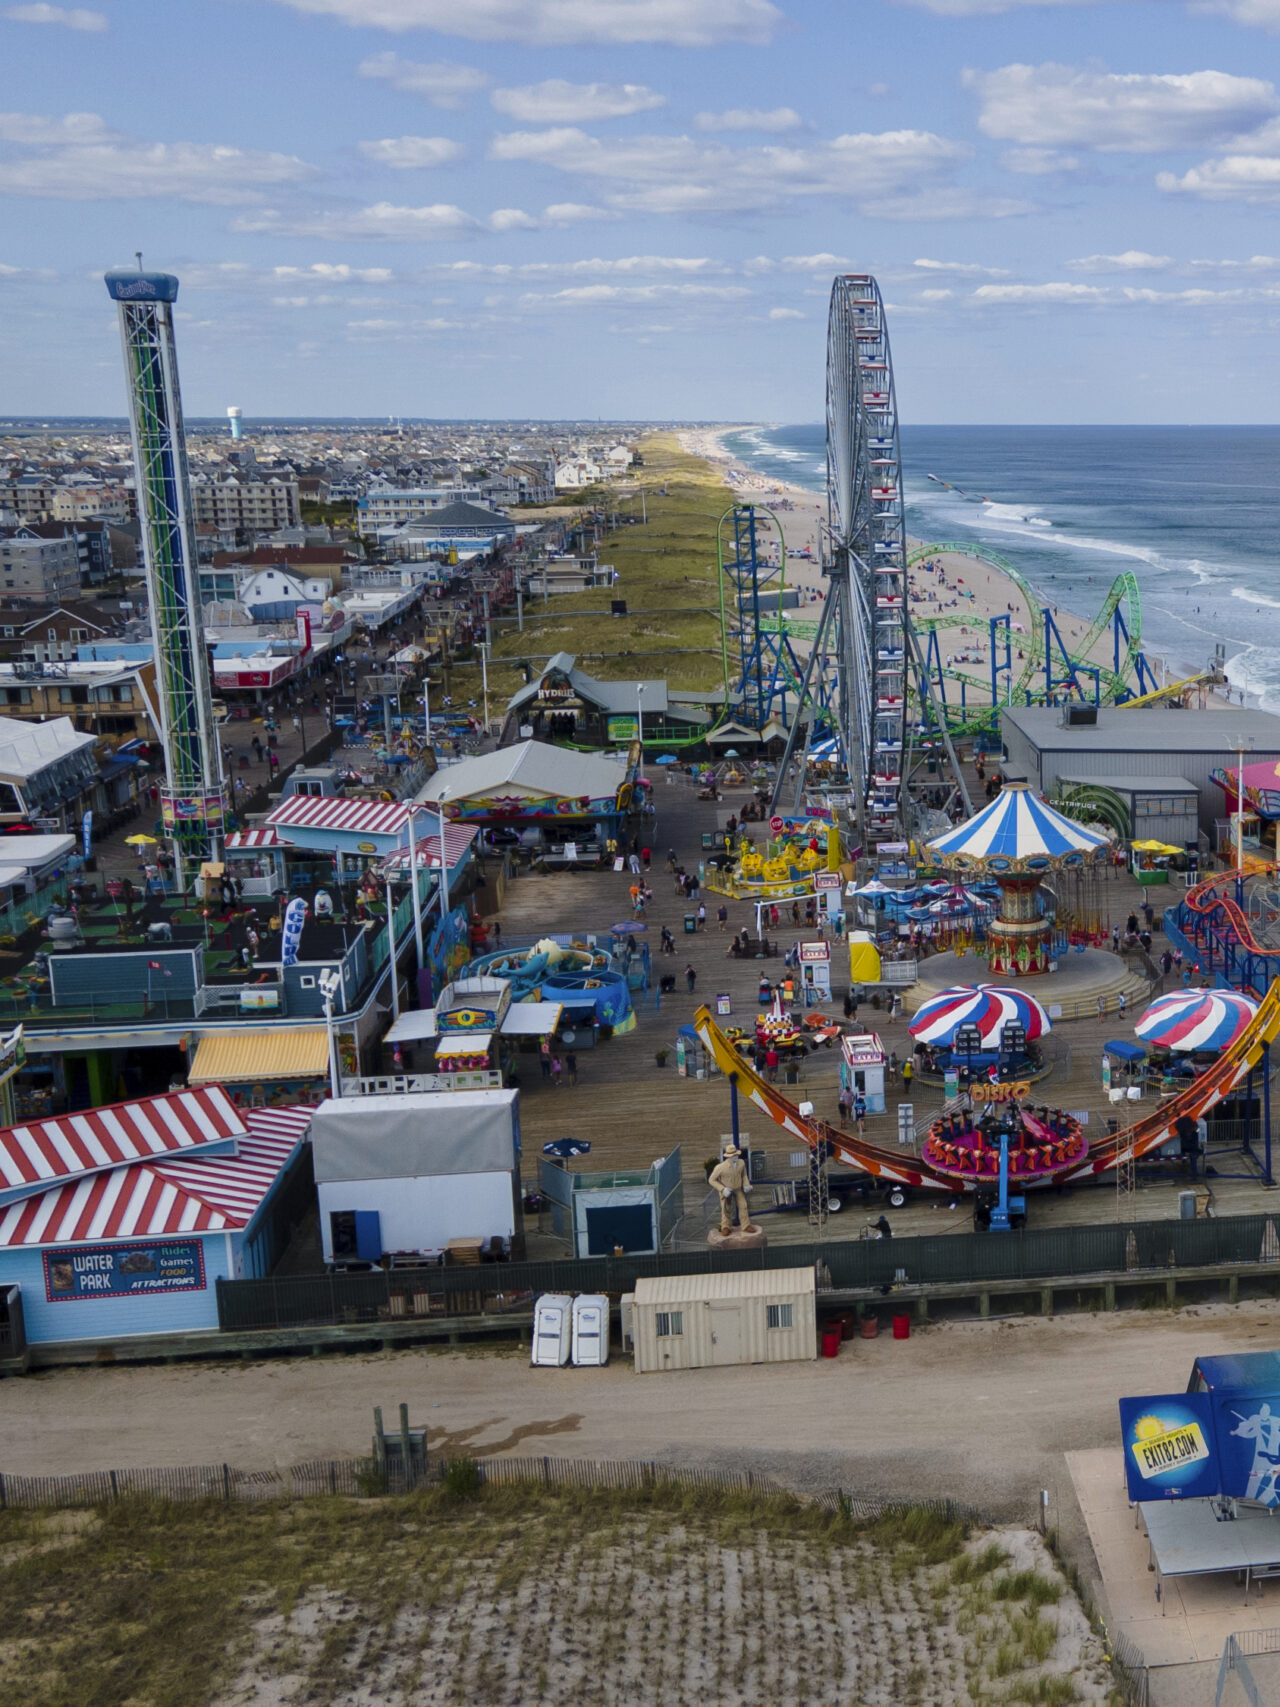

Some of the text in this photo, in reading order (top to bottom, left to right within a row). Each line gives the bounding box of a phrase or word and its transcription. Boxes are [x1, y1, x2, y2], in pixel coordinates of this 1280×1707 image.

[538, 688, 576, 699] HYDRUS
[1049, 799, 1097, 810] CENTRIFUGE
[161, 1247, 191, 1256] Rides
[73, 1254, 114, 1272] WATER
[160, 1258, 194, 1267] Games
[79, 1273, 112, 1291] PARK
[130, 1276, 195, 1289] ATTRACTIONS
[1142, 1432, 1199, 1469] EXIT82.COM
